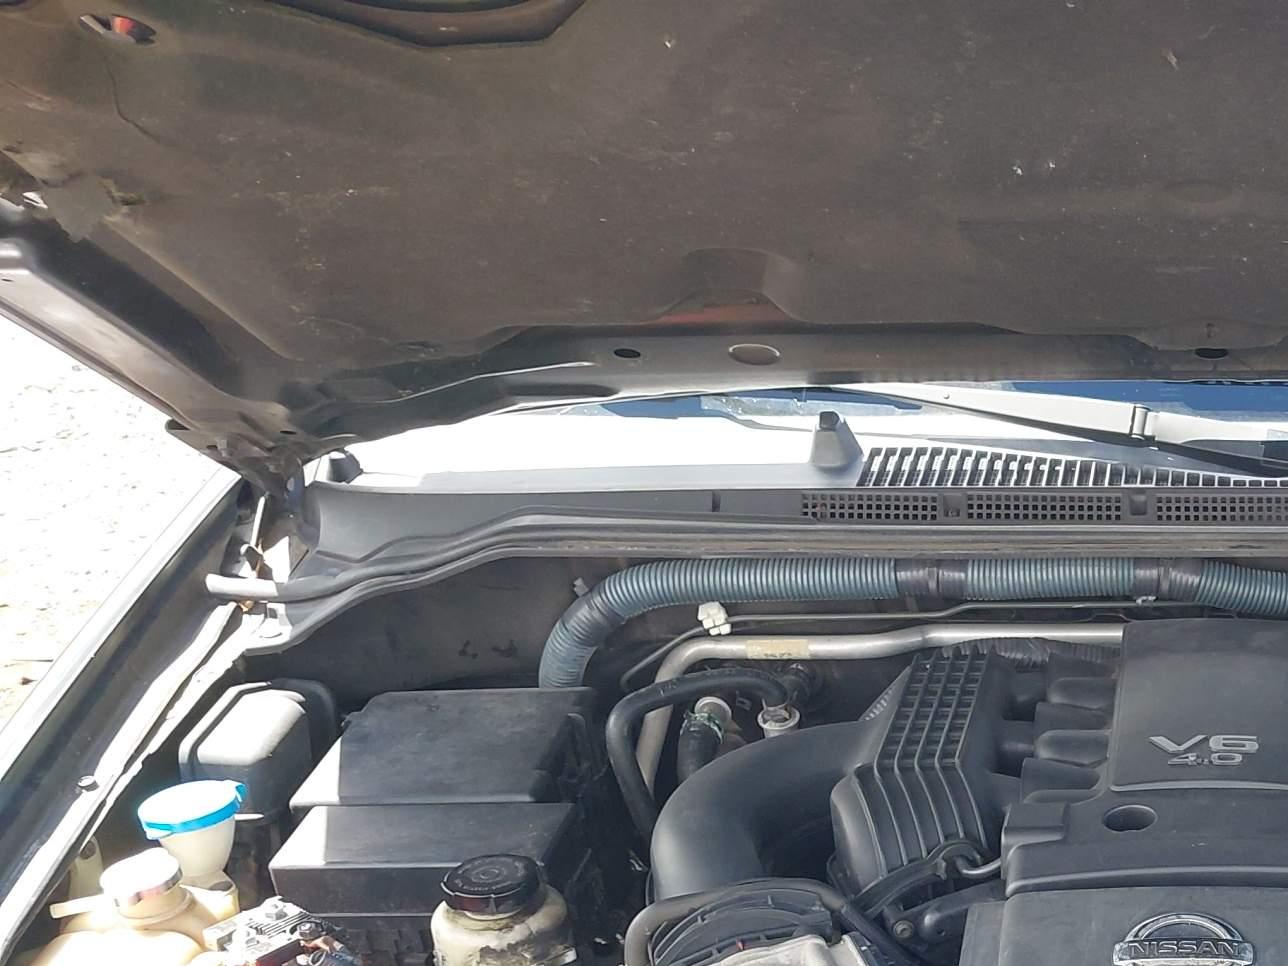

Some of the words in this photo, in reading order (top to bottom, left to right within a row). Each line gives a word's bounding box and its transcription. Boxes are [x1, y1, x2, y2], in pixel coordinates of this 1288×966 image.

[1148, 734, 1259, 753] V6
[1167, 752, 1242, 766] 4.0
[1128, 940, 1240, 957] NISSAN
